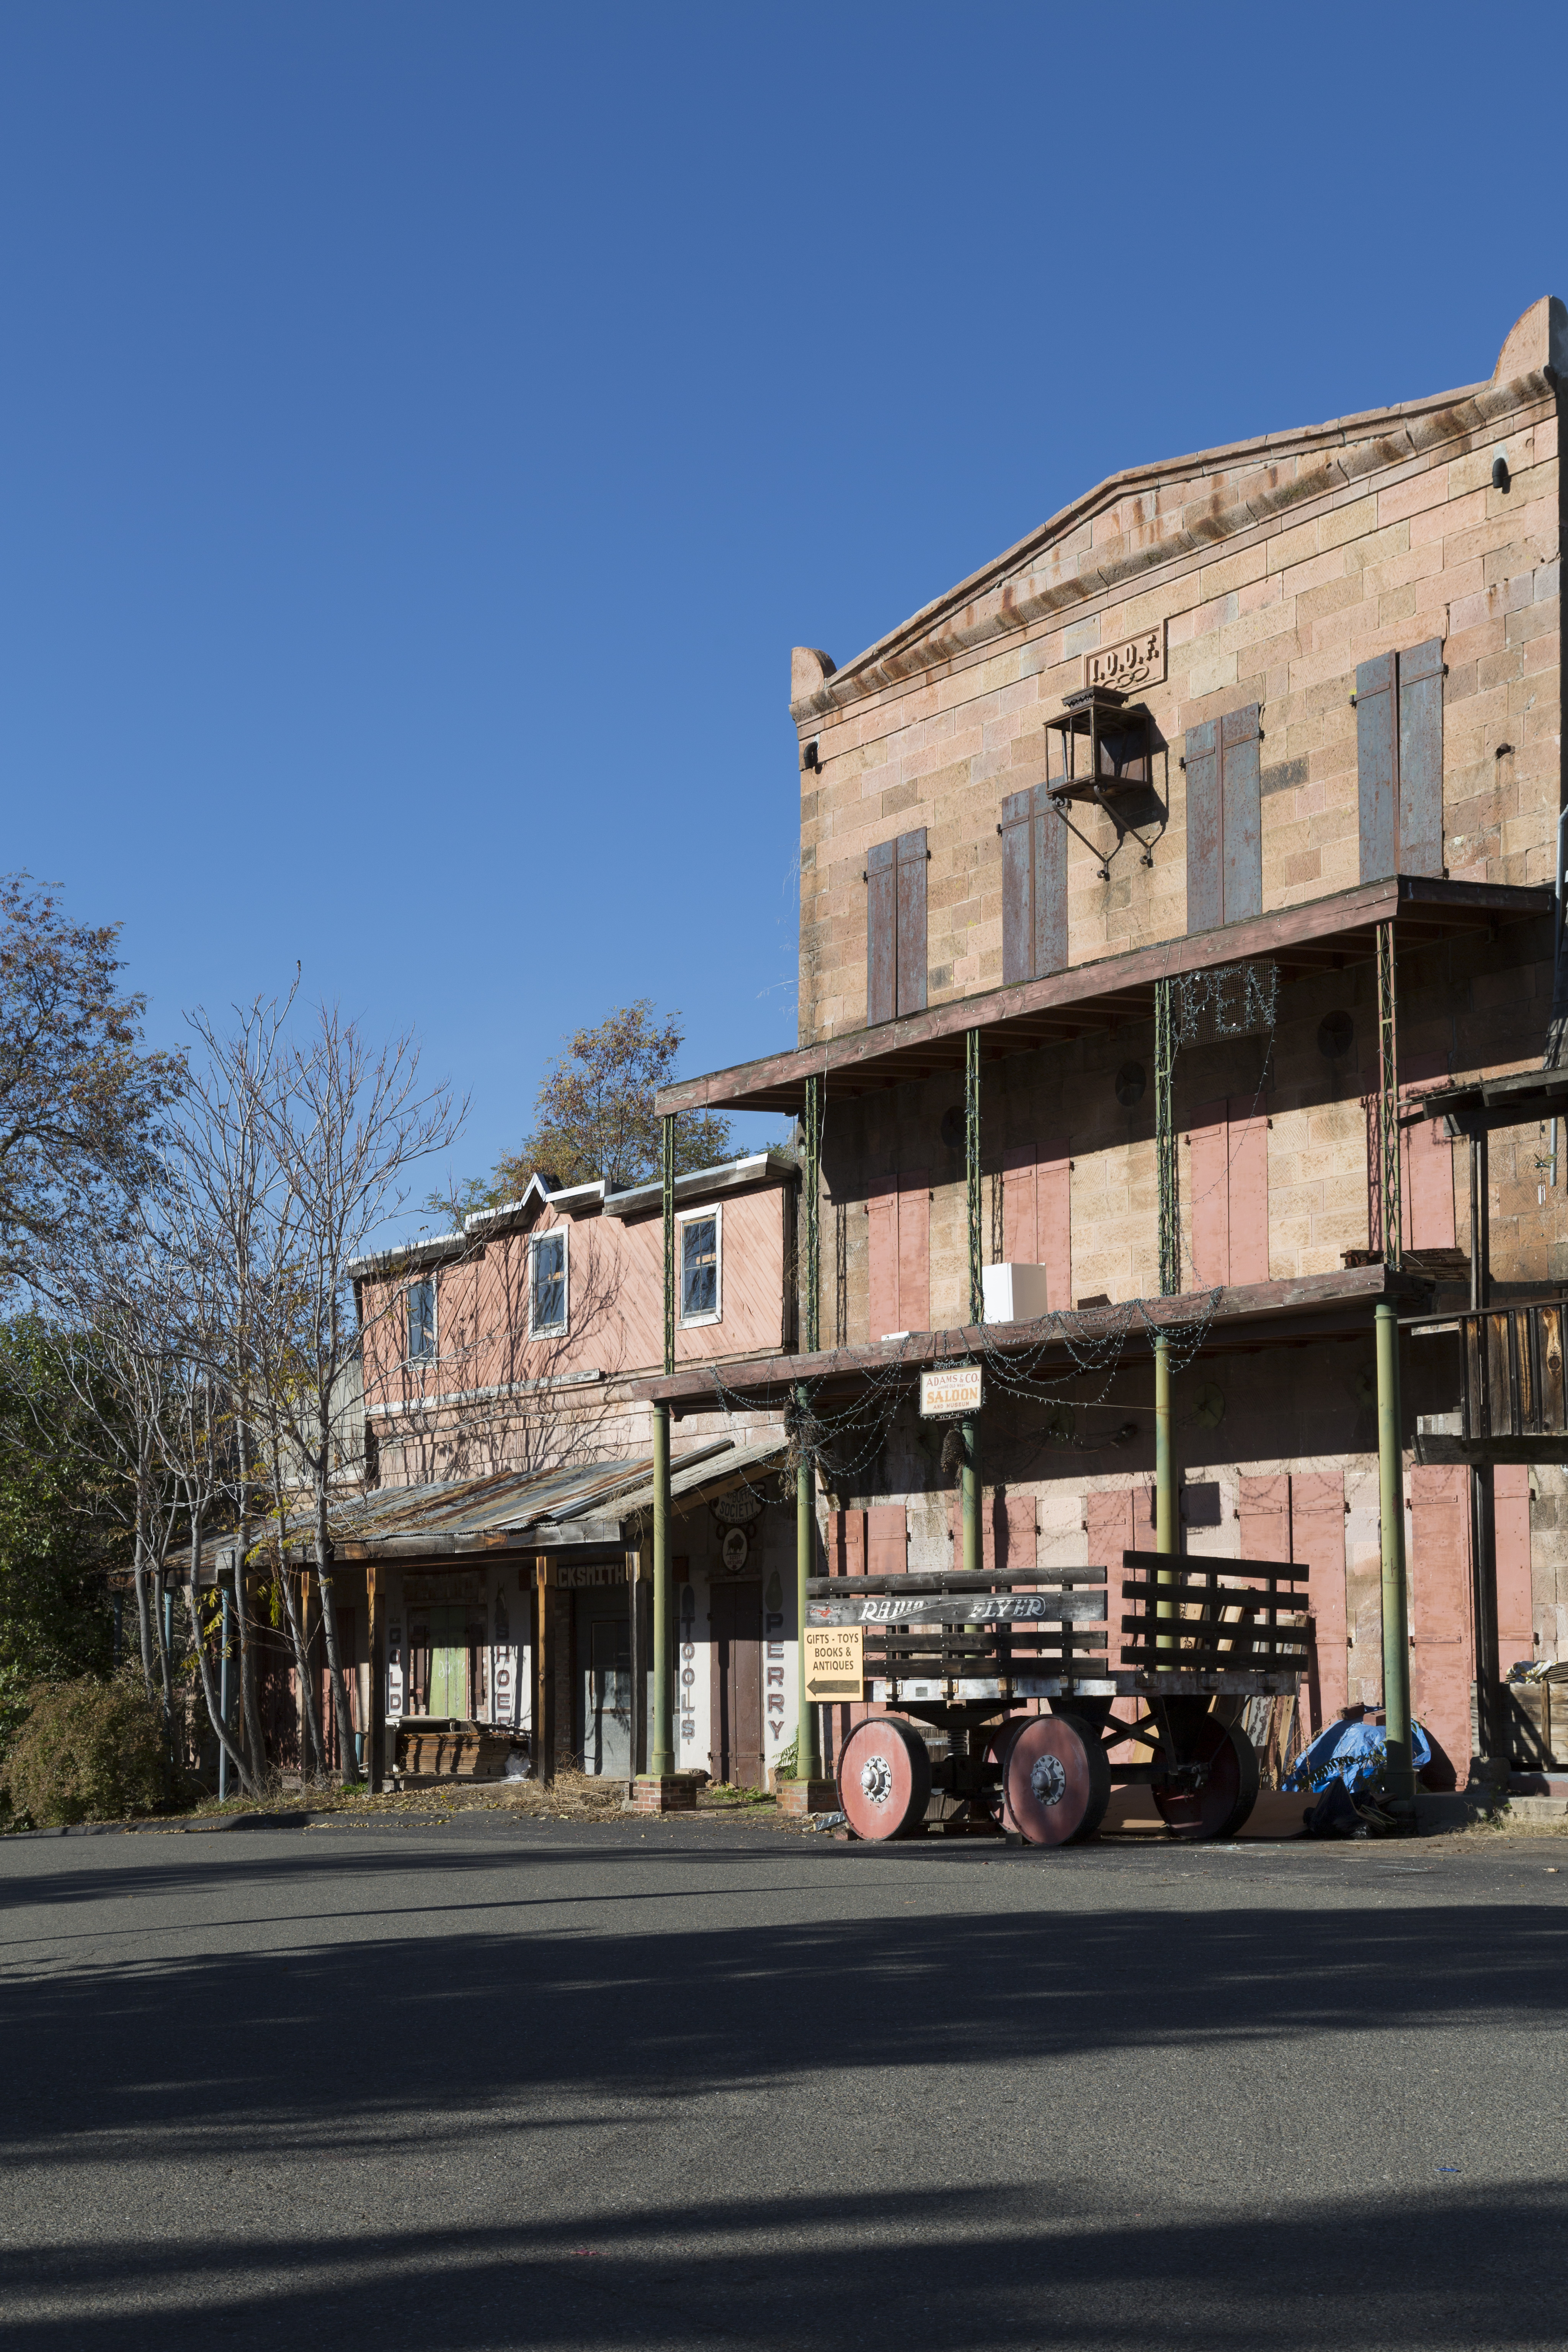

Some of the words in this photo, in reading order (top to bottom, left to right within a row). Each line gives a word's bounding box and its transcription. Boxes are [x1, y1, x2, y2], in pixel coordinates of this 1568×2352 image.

[926, 1375, 957, 1387] ADAMS
[959, 1374, 964, 1383] &
[965, 1373, 979, 1383] CO.
[927, 1387, 978, 1405] SALOON
[720, 1499, 754, 1517] SOCIETY
[531, 1565, 624, 1589] BCKSMITH
[968, 1597, 1045, 1618] FLYER
[807, 1634, 829, 1644] GIFTS
[837, 1633, 859, 1643] TOYS
[815, 1647, 843, 1657] BOOKS
[846, 1647, 851, 1657] &
[813, 1660, 854, 1671] ANTIQUES
[681, 1616, 695, 1739] TOOLS
